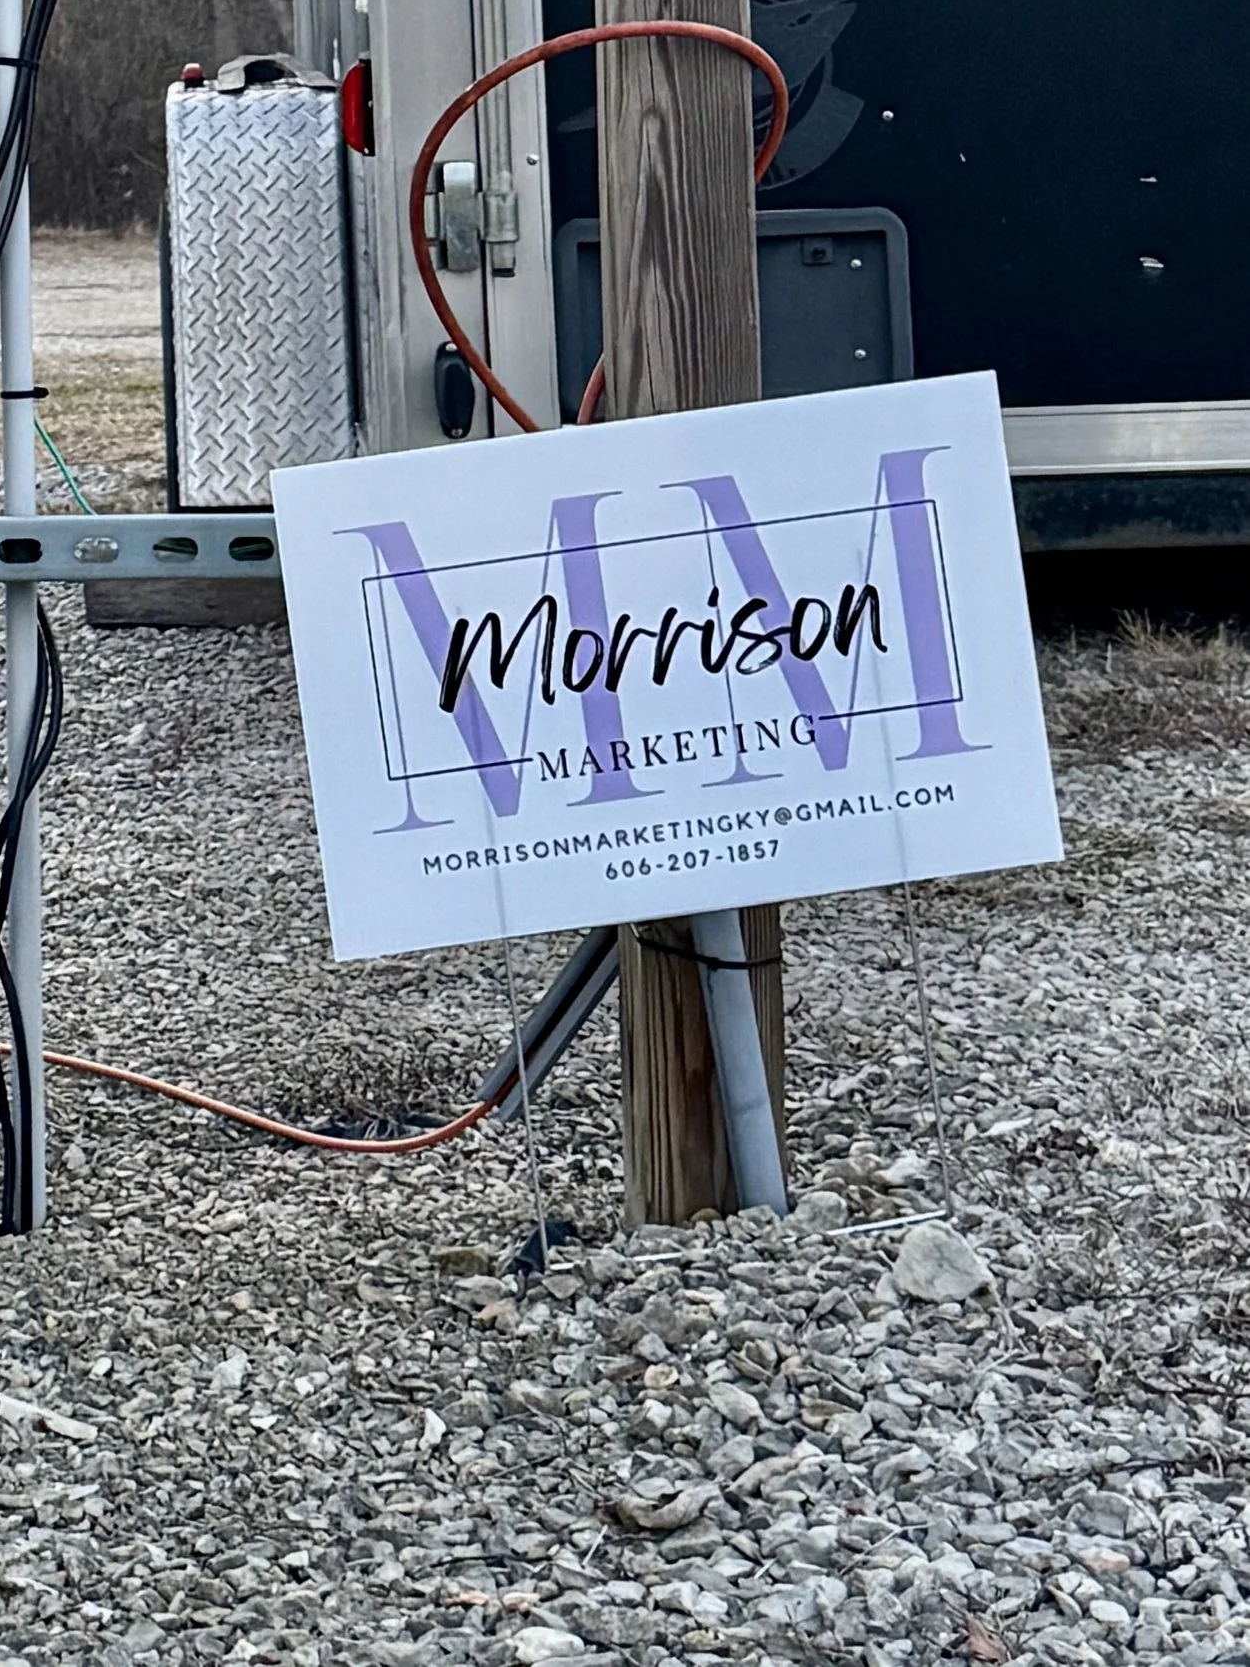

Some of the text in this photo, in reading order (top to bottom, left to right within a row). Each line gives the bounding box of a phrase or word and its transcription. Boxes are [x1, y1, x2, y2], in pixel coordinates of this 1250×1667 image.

[439, 583, 888, 714] Morrison
[537, 713, 820, 782] MARKETING
[422, 784, 956, 876] MORRISONMARKETINGKY@GMAIL.COM
[604, 839, 781, 882] 606-207-1857
